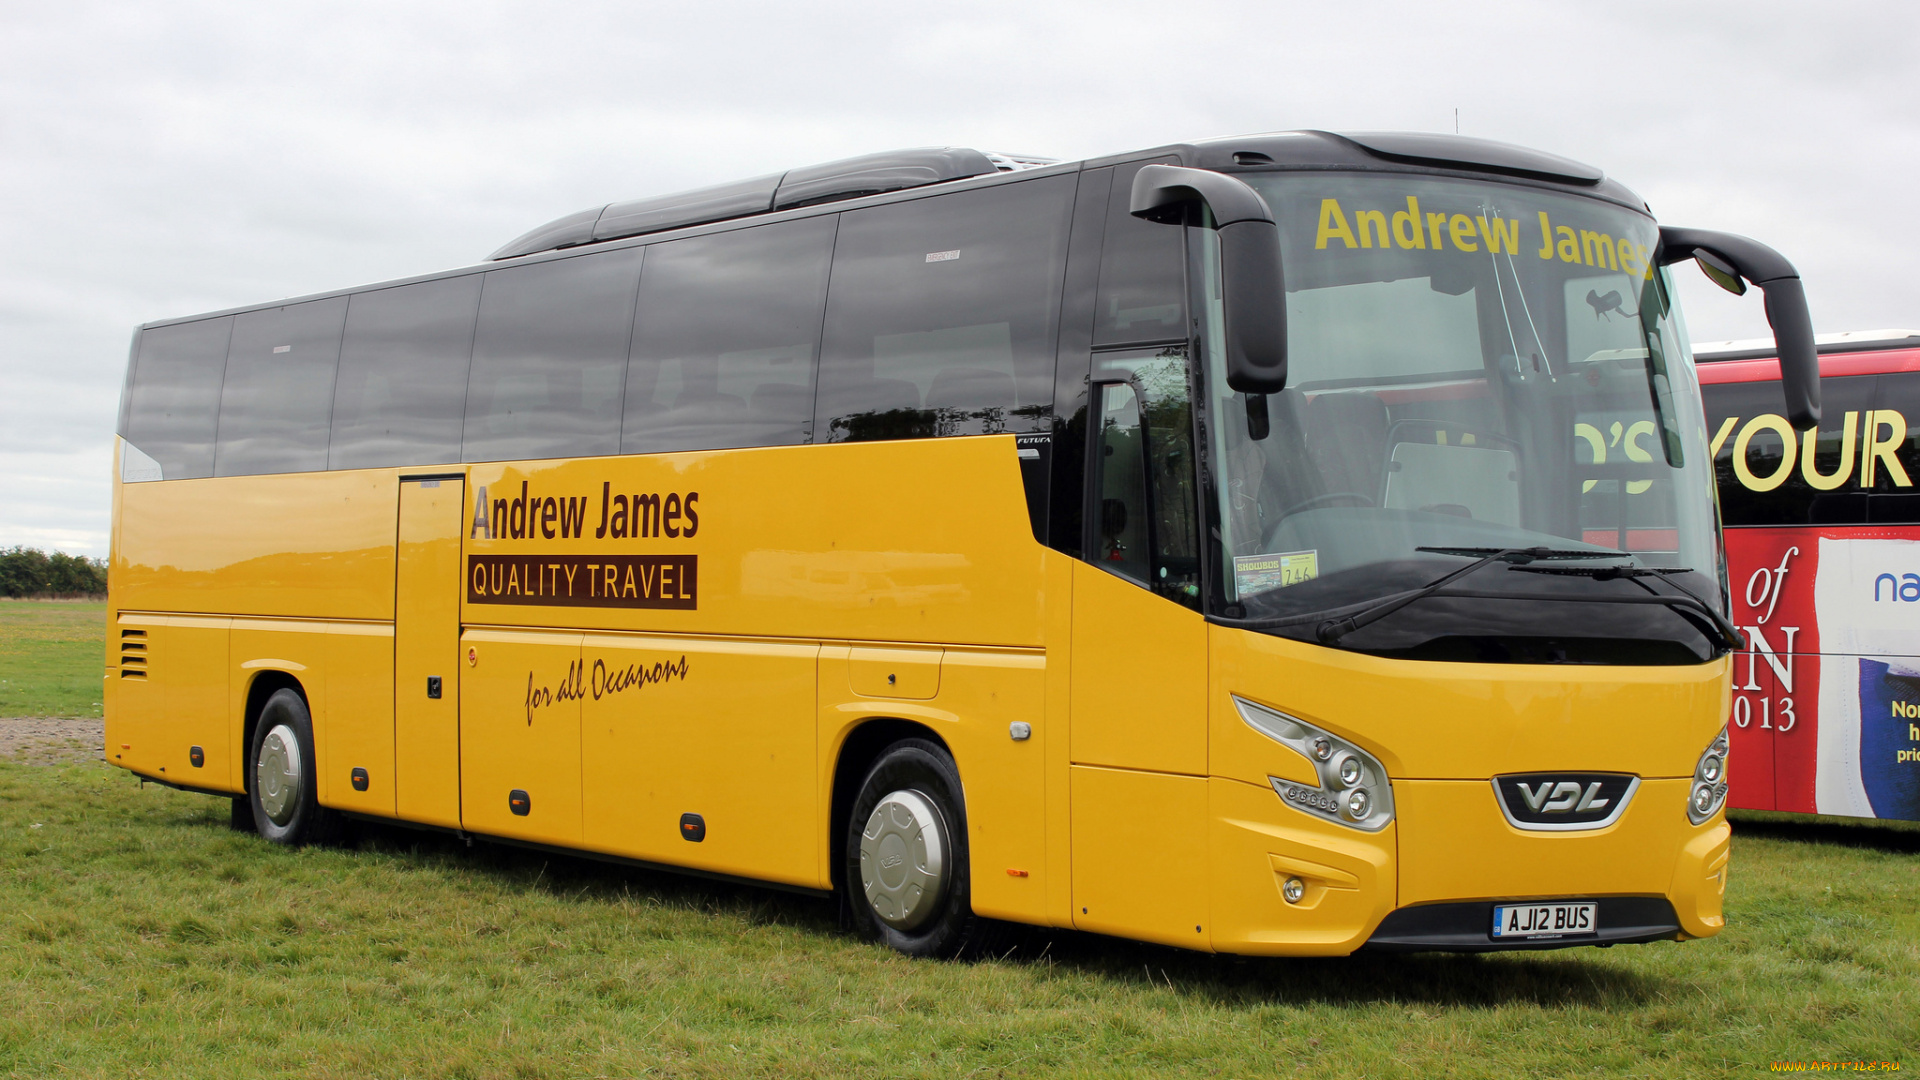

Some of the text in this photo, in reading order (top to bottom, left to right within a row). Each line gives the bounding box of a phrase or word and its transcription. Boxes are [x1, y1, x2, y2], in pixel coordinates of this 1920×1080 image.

[1315, 196, 1653, 280] Andrew James
[470, 480, 699, 540] Andrew James
[472, 562, 691, 600] QUALITY TRAVEL
[1285, 567, 1312, 586] 246
[1746, 546, 1799, 624] of
[525, 654, 690, 727] for all Occasions
[1516, 781, 1610, 814] VDL
[1508, 906, 1590, 932] AJ12 BUS
